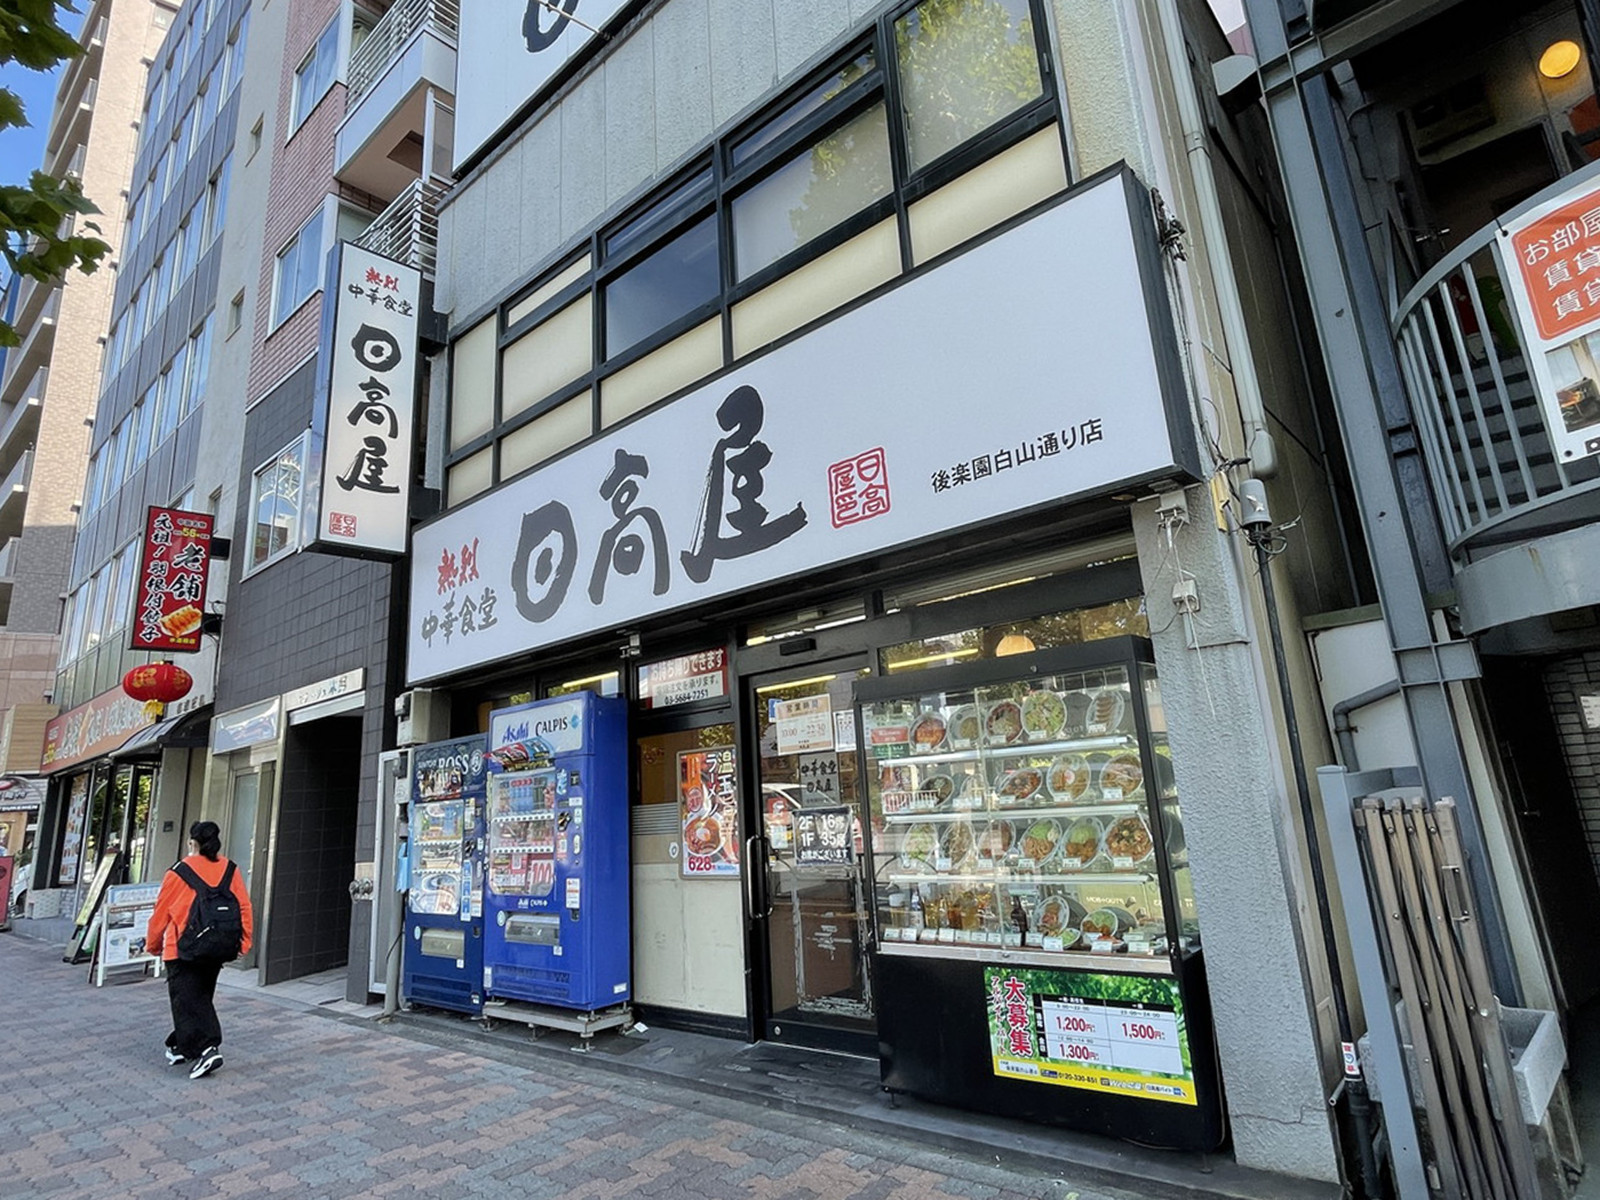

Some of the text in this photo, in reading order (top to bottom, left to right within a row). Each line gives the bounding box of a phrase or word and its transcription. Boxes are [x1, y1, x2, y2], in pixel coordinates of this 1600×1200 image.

[348, 283, 413, 317] 中華食堂
[365, 266, 400, 292] 熱烈
[336, 323, 402, 494] 日高屋
[931, 418, 1103, 493] 後楽園白山通り店
[511, 385, 808, 623] 日高屋
[170, 542, 205, 602] 老舗
[437, 537, 480, 595] 熱烈
[421, 587, 499, 648] 中華食堂
[502, 716, 568, 744] Asahi CALPIS
[799, 816, 813, 830] 2F
[801, 832, 815, 847] 1F
[1004, 977, 1033, 1057] 大募集
